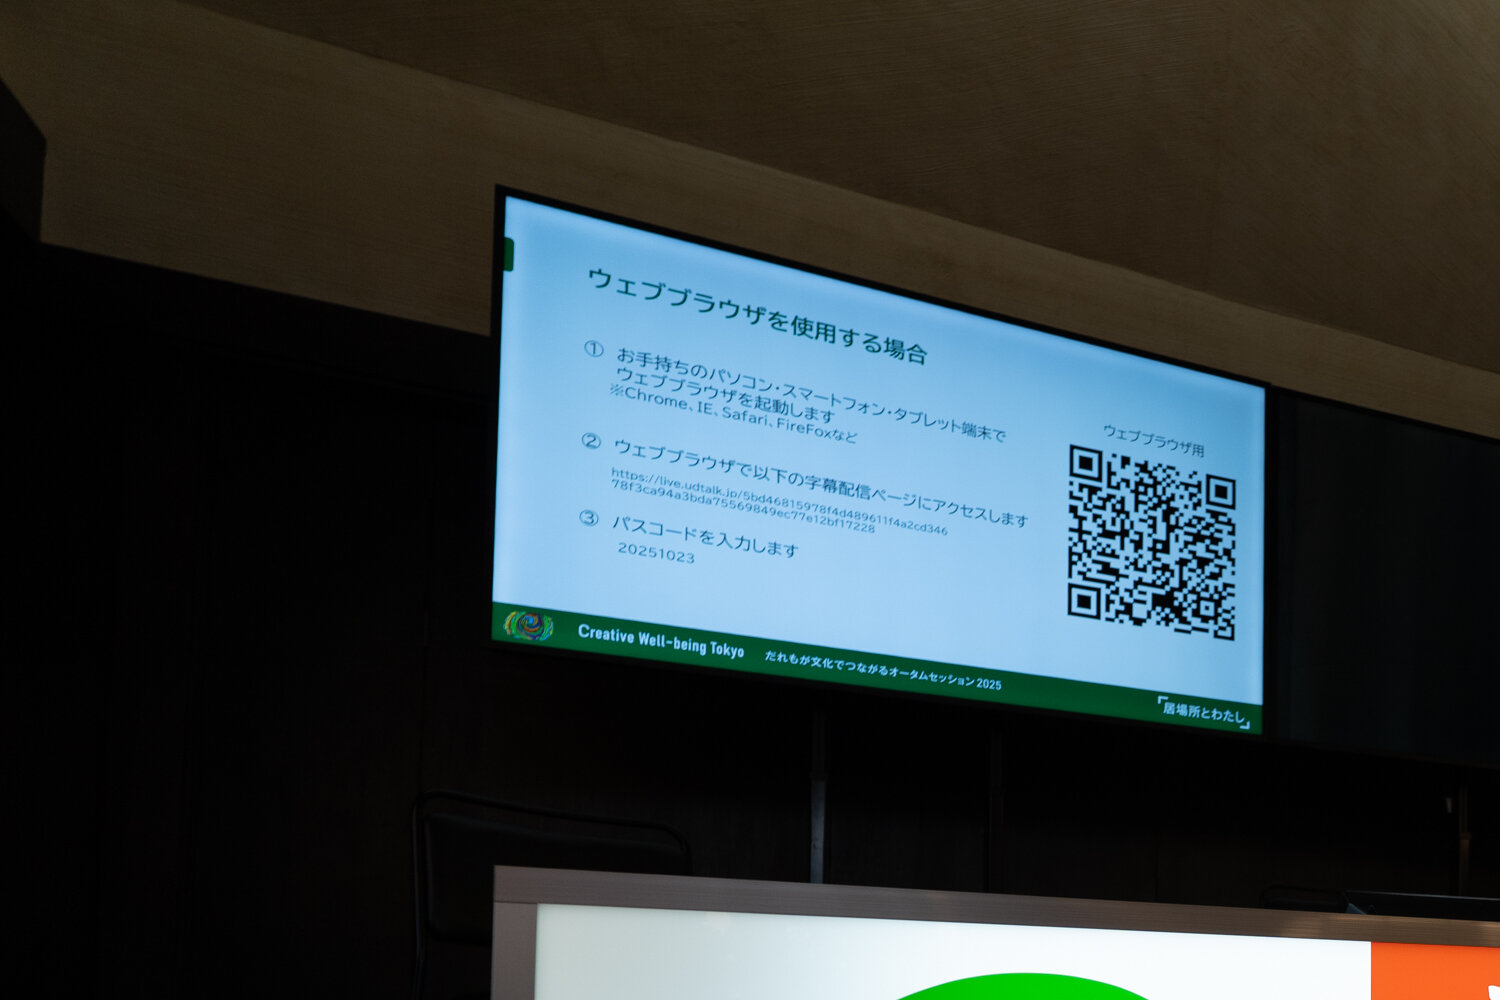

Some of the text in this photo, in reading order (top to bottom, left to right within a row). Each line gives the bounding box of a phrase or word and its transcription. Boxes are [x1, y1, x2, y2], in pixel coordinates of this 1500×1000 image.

[589, 267, 928, 366] ウェブブラウザを使用する場合
[616, 366, 836, 424] ウェブブラウザを起動します
[617, 348, 1007, 443] お手持ちのパソコン・スマートフォン・タブレット端末で
[1103, 424, 1205, 458] ウェブブラウザ用
[611, 467, 948, 536] https://live.udtalk.jp/5bd46815978f4d489611f4a2cd346
[611, 479, 876, 534] 78f3ca94a3bda75569849ec77e12bf17228
[614, 439, 1029, 528] ウェブブラウザで以下の字幕配信ページにアクセスします
[612, 516, 799, 559] パスコードを入力します
[617, 542, 695, 564] 20251023
[578, 624, 745, 659] Creative Well-being Tokyo
[765, 650, 1002, 690] だれもが文化でつながるオータムセッション 2025
